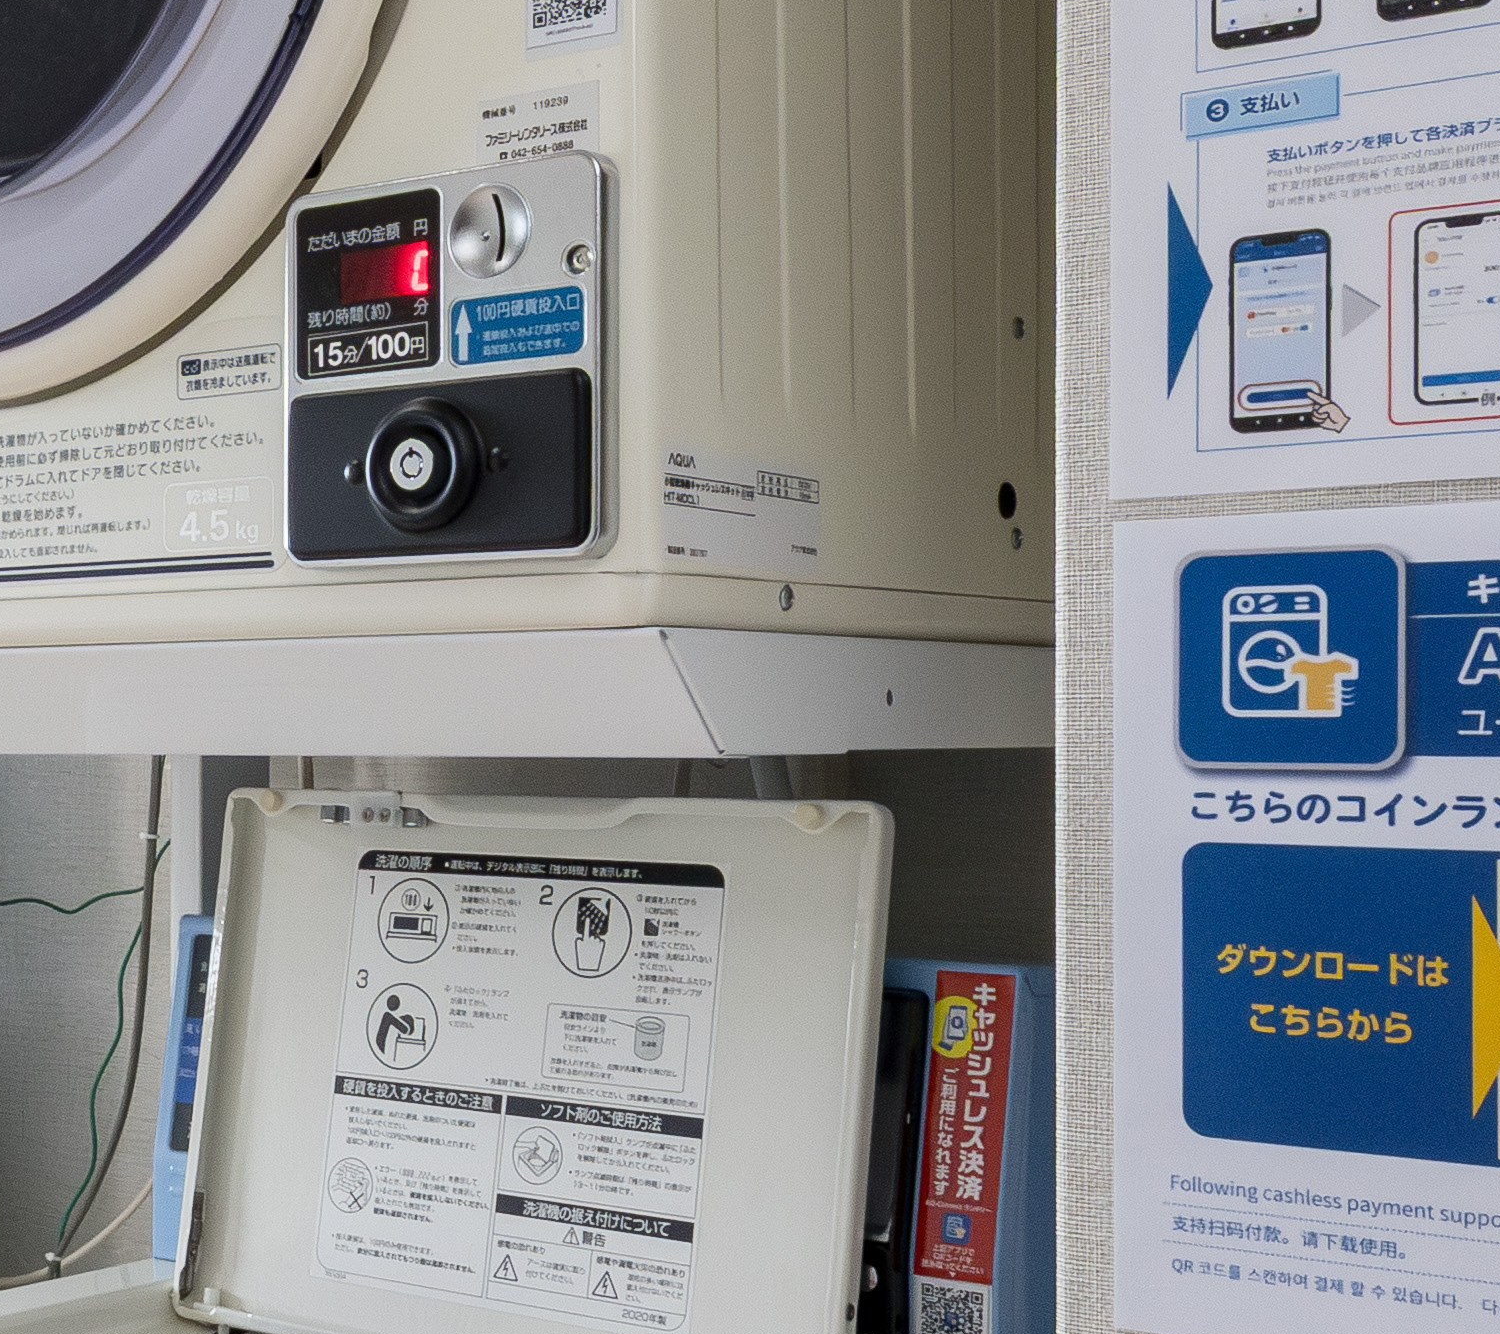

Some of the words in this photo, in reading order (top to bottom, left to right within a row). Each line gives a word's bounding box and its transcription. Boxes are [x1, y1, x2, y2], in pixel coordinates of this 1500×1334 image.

[1239, 91, 1301, 117] 支払い
[1424, 144, 1453, 158] make
[307, 221, 401, 254] ただいまの金額
[413, 218, 429, 235] 円
[413, 299, 429, 317] 分
[476, 292, 582, 322] 100円硬貨投入口
[311, 331, 426, 369] 15分/100円
[668, 451, 697, 470] AQUA
[179, 509, 230, 544] 4.5
[234, 519, 260, 544] kg
[374, 853, 433, 870] 洗濯の順序
[1216, 943, 1450, 988] ダウンロードは
[1248, 1003, 1415, 1045] こちらから
[342, 1078, 494, 1111] 硬貨を投入するときのご注意
[955, 982, 998, 1202] キャッシュレス決済
[540, 1102, 664, 1133] ソフト剤のご使用方法
[933, 1067, 959, 1198] ご利用になれます
[1169, 1173, 1259, 1203] Following
[1262, 1183, 1343, 1210] cashless
[1346, 1196, 1435, 1221] payment
[522, 1199, 671, 1237] 洗濯機の据え付けについて
[582, 1230, 607, 1248] 警告
[1171, 1257, 1194, 1276] QR
[1370, 1283, 1386, 1301] 수
